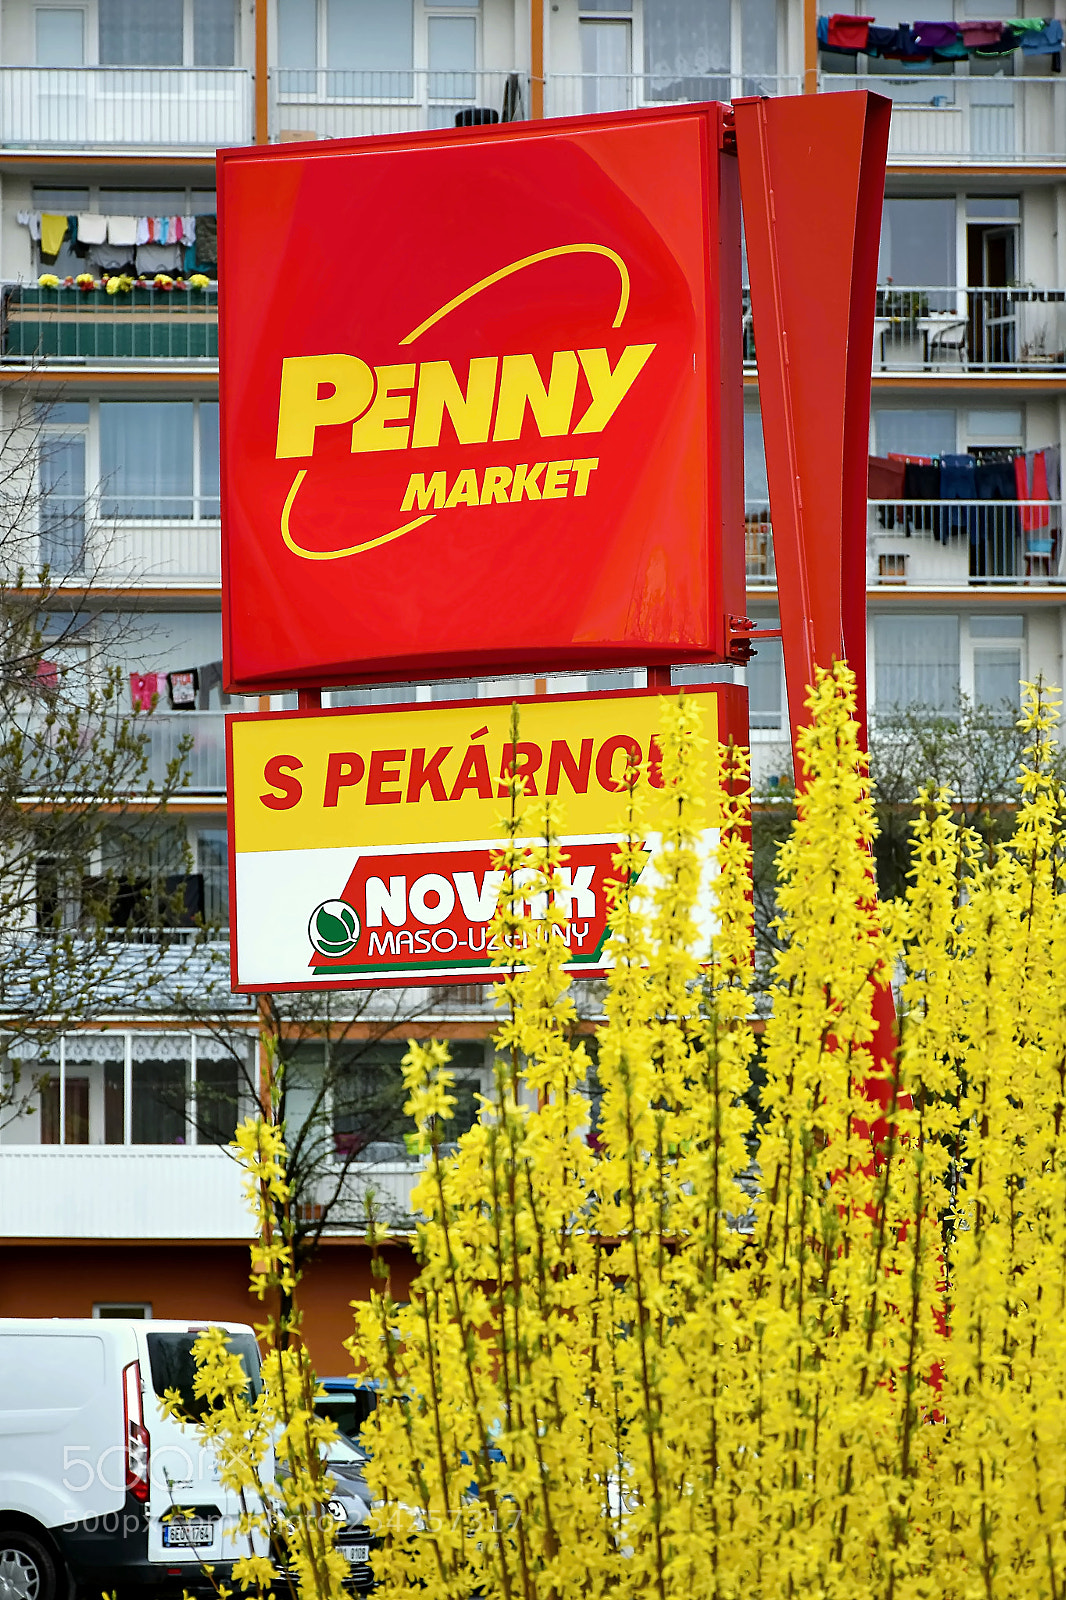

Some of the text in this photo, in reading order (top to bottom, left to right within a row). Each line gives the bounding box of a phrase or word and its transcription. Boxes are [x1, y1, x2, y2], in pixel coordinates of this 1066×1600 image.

[275, 343, 657, 460] PENNY
[400, 457, 599, 512] MARKET
[259, 754, 303, 811] S
